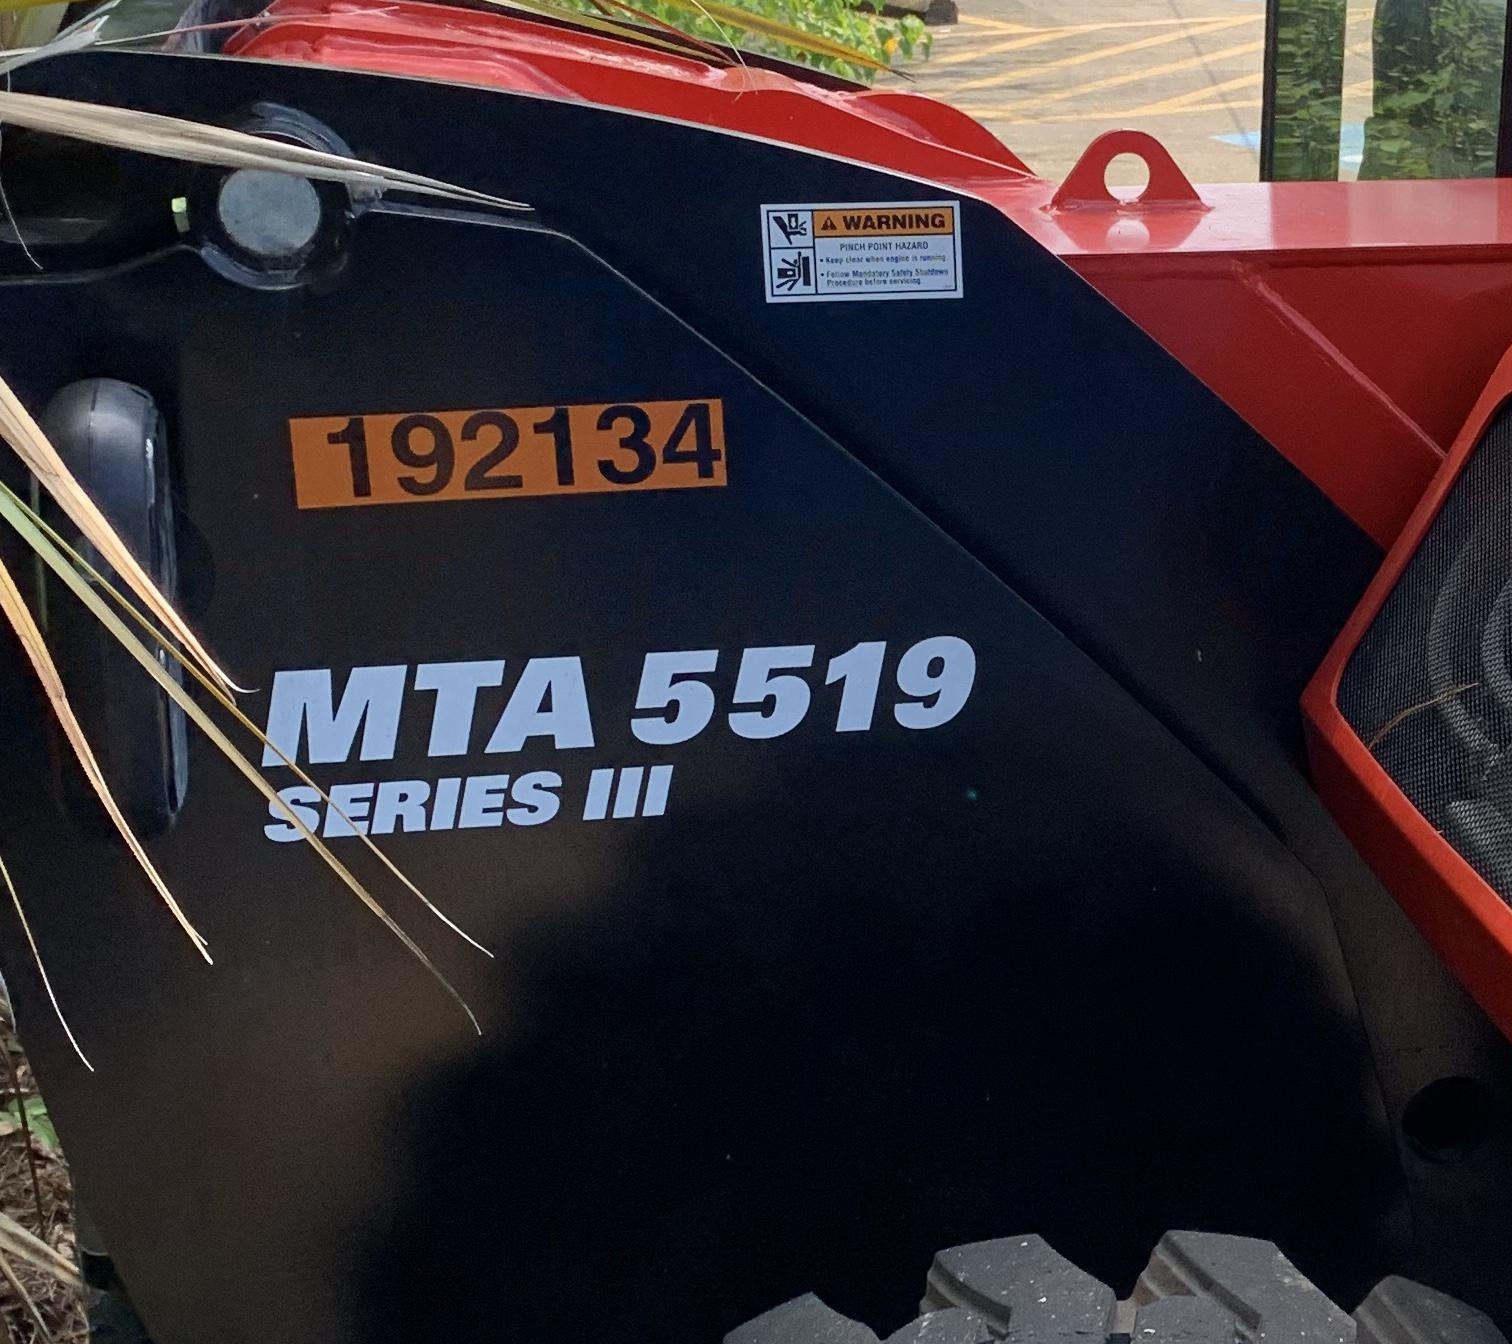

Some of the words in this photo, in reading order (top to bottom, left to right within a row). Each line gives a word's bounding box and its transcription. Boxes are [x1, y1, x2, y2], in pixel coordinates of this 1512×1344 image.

[840, 242, 866, 252] PINCH
[868, 241, 893, 251] POINT
[895, 240, 929, 250] HAZARD
[842, 213, 945, 230] WARNING
[326, 403, 723, 498] 192134
[261, 656, 594, 768] MTA
[630, 635, 976, 745] 5519
[263, 769, 563, 843] SERIES
[582, 765, 675, 820] III
